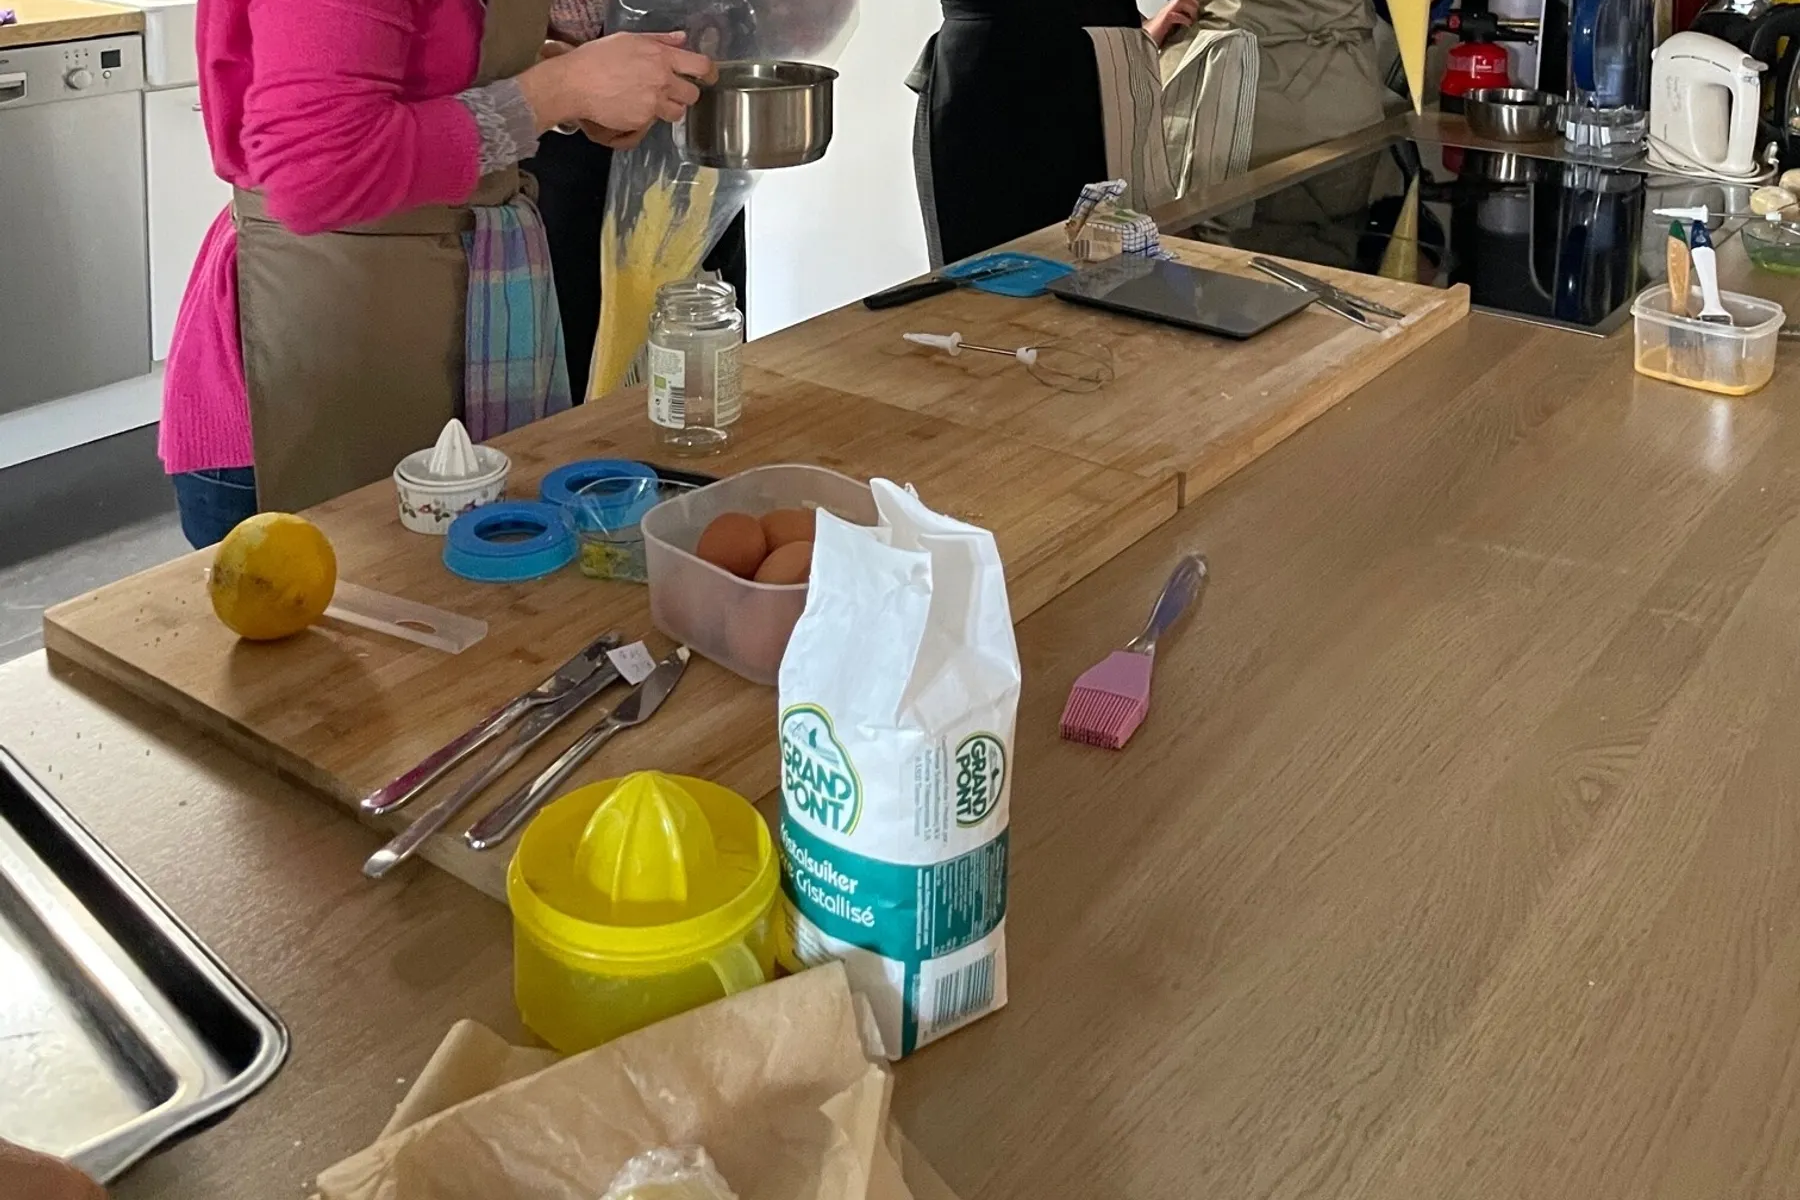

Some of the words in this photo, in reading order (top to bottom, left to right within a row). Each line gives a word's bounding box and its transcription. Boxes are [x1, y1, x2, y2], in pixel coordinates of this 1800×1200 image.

[783, 736, 852, 801] GRAND
[957, 754, 971, 816] PONT
[971, 740, 987, 816] GRAND
[785, 769, 844, 831] PONT
[796, 869, 875, 927] Cristallisé
